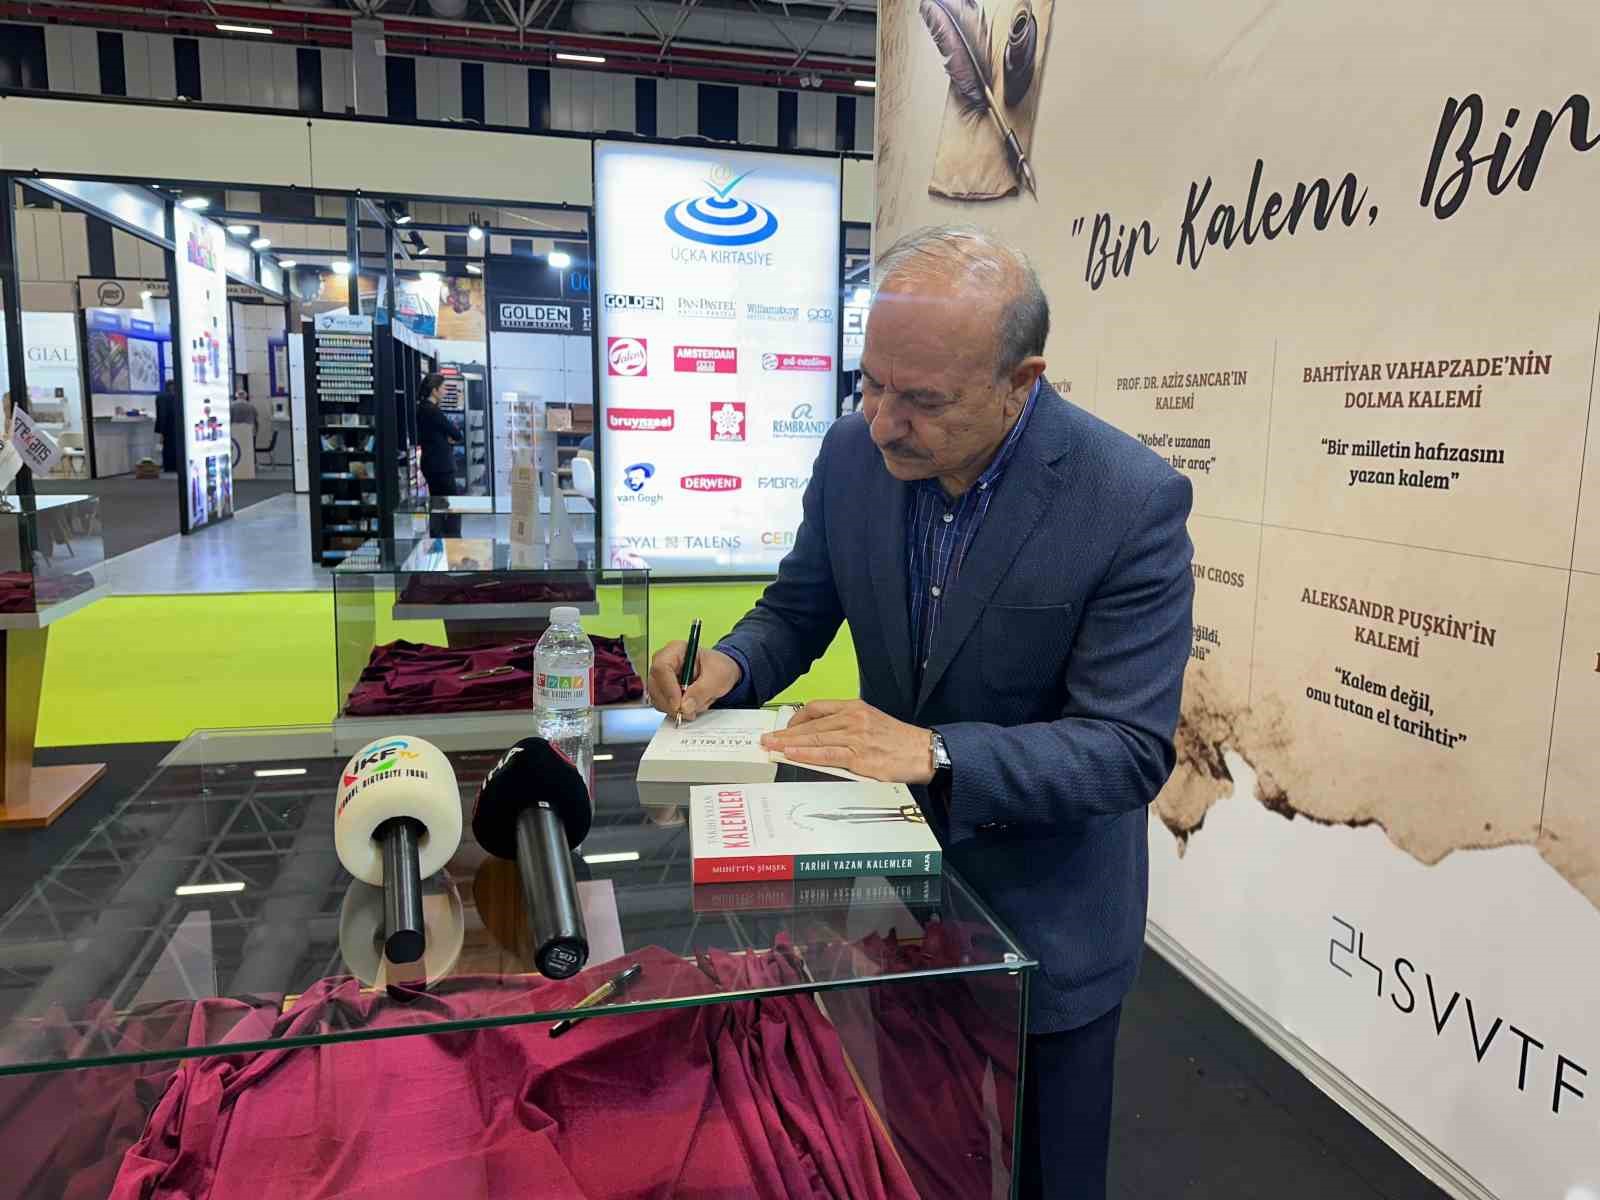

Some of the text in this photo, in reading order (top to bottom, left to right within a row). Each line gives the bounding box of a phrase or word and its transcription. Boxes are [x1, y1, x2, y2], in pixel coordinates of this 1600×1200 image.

[1176, 158, 1378, 270] Kalem,
[605, 294, 664, 310] GOLDEN
[502, 305, 568, 321] GOLDEN
[676, 347, 736, 360] AMSTERDAM
[1303, 349, 1553, 383] BAHTİYAR VAHAPZADE’NİN
[1116, 370, 1248, 391] PROF. DR. AZİZ SANCAR'IN
[1155, 392, 1195, 410] KALEMİ
[1344, 384, 1483, 409] DOLMA KALEMİ
[1175, 436, 1211, 449] uzanan
[1321, 437, 1505, 465] “Bir milletin hafızasını
[1172, 455, 1187, 470] bir
[684, 477, 738, 491] DERWENT
[1348, 468, 1460, 490] yazan kalem”
[637, 492, 664, 506] Gogh
[685, 535, 742, 549] TALENS
[1208, 567, 1246, 588] CROSS
[1300, 587, 1497, 648] ALEKSANDR PUŞKİN’İN
[1354, 625, 1420, 659] KALEMİ
[1334, 666, 1435, 716] “Kalem değil,
[1306, 686, 1331, 705] onu
[1334, 694, 1374, 720] tutan
[1377, 707, 1391, 726] el
[718, 790, 751, 849] KALEMLER
[800, 857, 913, 871] TARİHİ YAZAN KALEMLER
